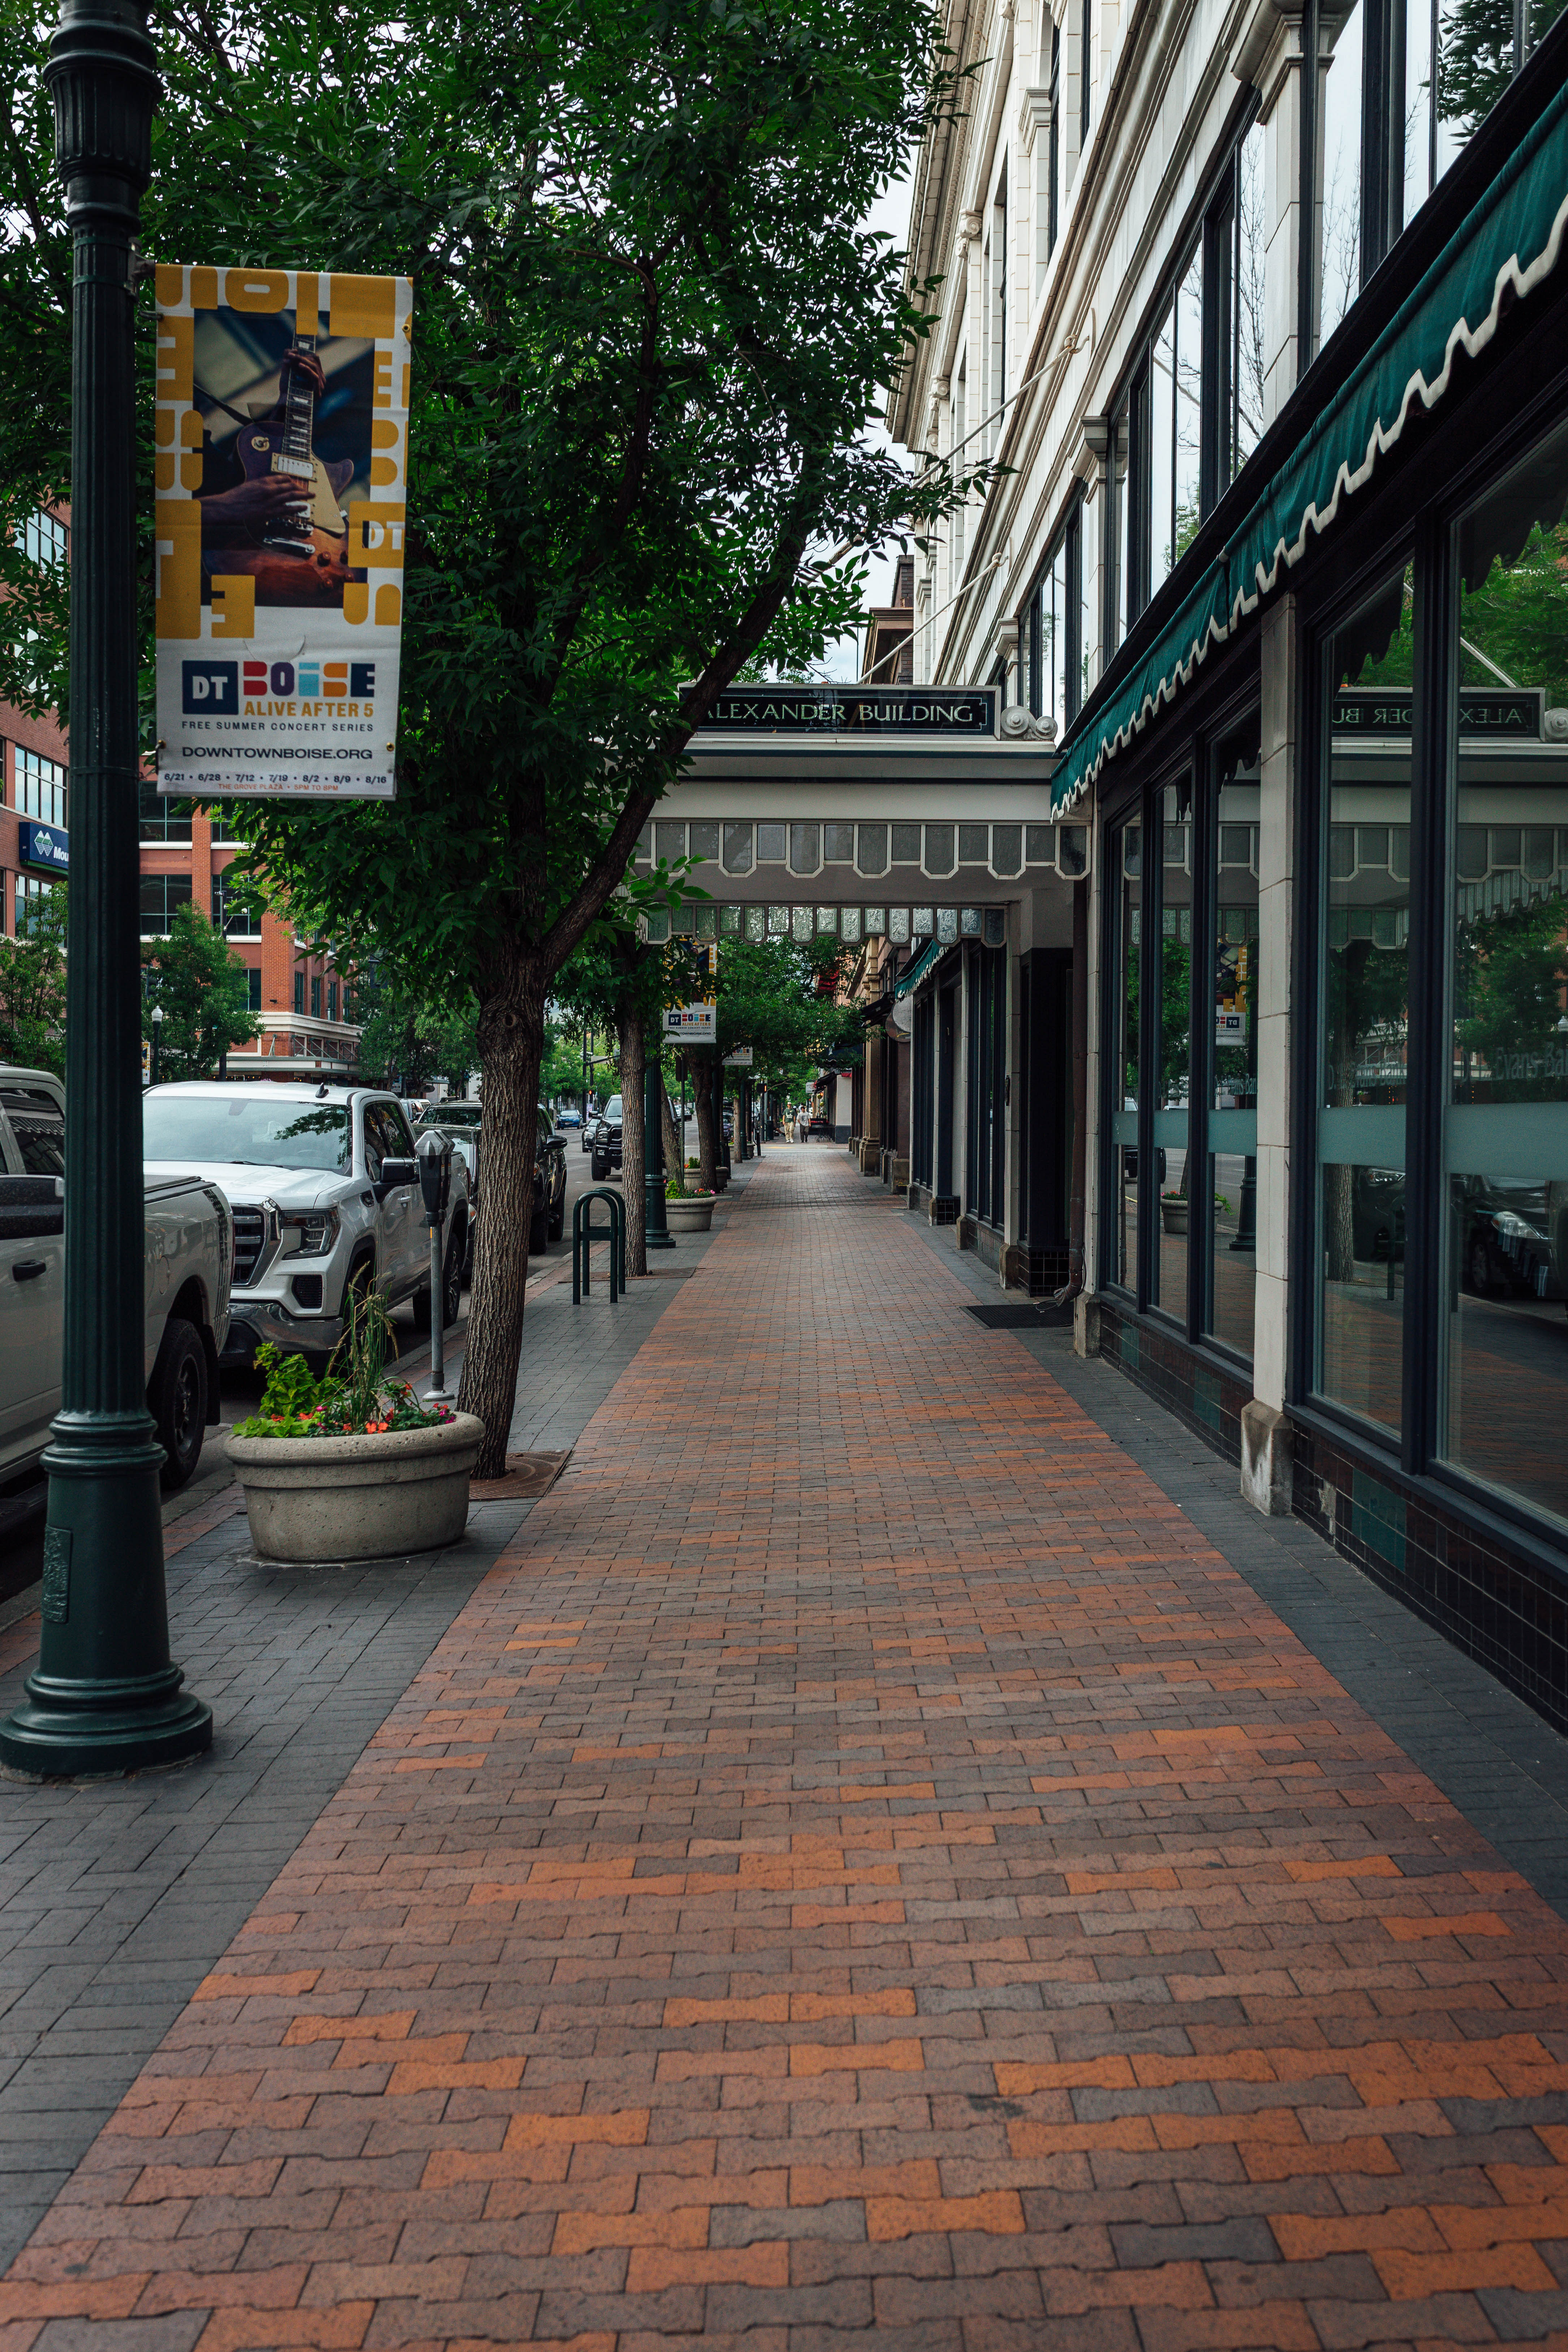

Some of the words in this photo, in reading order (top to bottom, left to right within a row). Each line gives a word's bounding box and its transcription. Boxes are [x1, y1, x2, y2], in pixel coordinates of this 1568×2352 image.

[362, 520, 405, 549] DT
[193, 676, 228, 699] DT
[243, 661, 375, 697] BOISE
[244, 701, 296, 716] ALIVE
[301, 702, 358, 717] AFTER
[363, 703, 373, 717] 5
[708, 703, 847, 720] LEXANDER
[860, 705, 973, 721] BUILDING
[216, 722, 265, 730] SUMMER
[271, 723, 326, 731] CONCERT
[182, 747, 372, 759] DOWNTOWNBOISE.ORG
[164, 773, 185, 781] 6/21
[236, 774, 255, 783] 7/12
[269, 774, 288, 783] 7/19
[303, 774, 320, 783] 8/2
[333, 775, 351, 784] 8/9
[365, 775, 387, 784] 8/16
[53, 846, 69, 862] Mou
